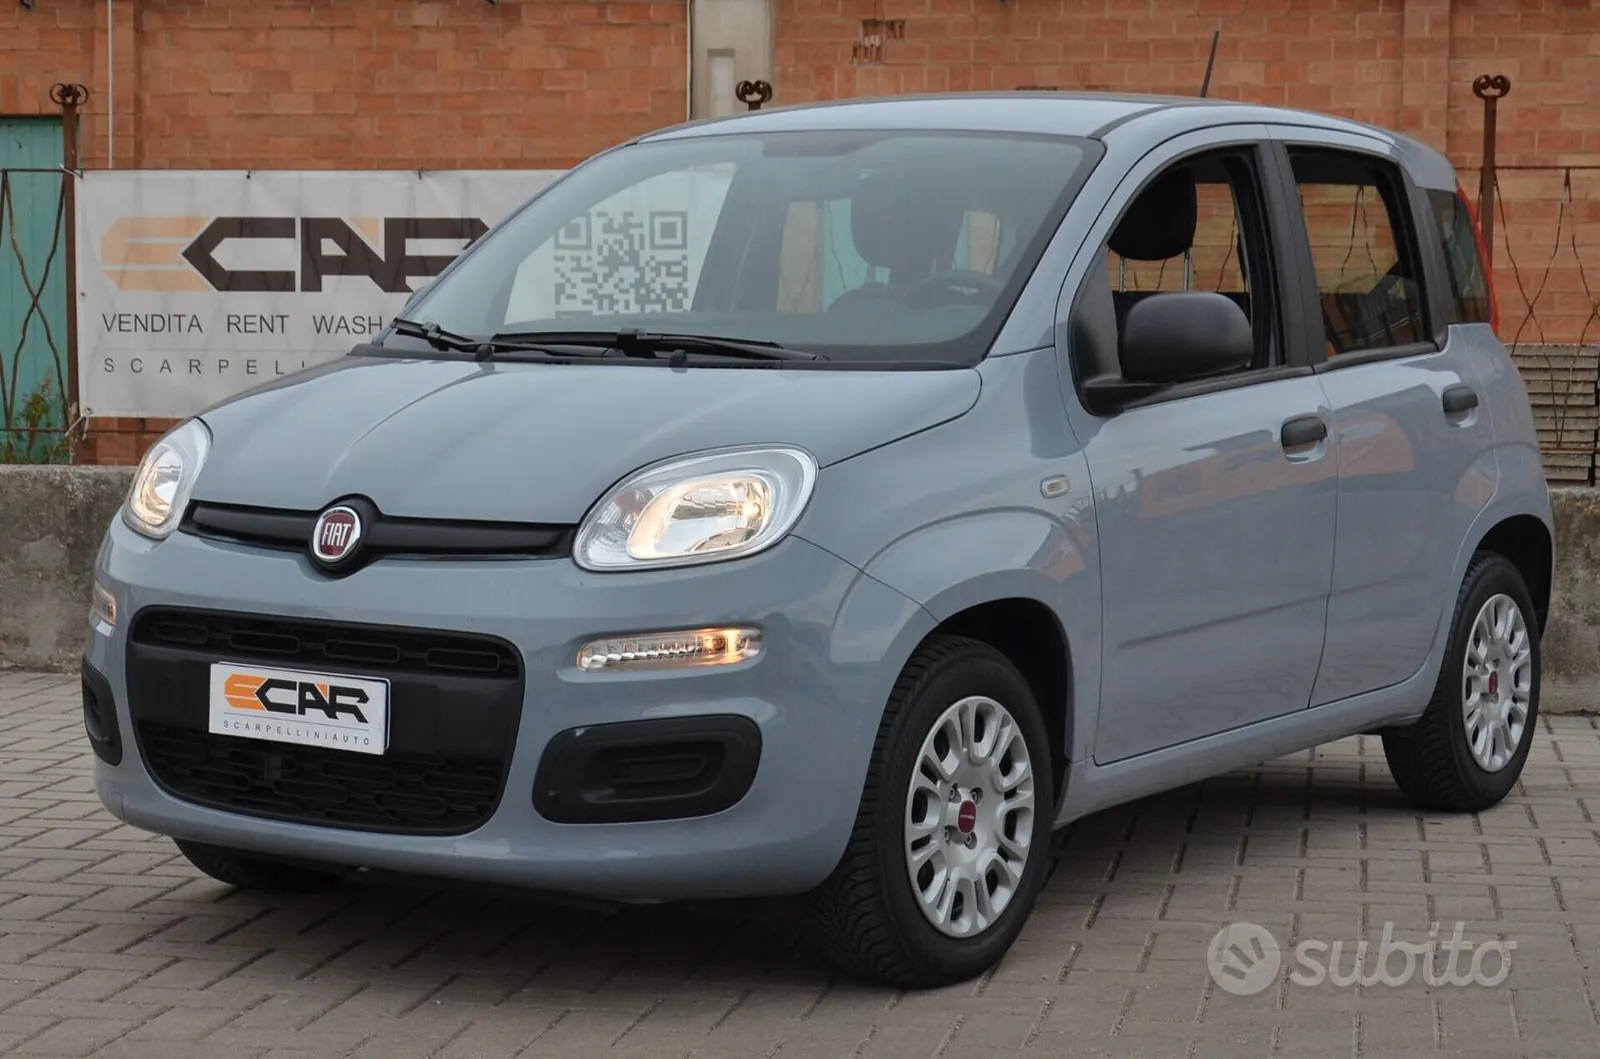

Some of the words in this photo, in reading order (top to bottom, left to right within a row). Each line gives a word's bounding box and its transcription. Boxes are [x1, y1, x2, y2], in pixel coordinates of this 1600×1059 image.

[101, 313, 203, 334] VENDITA
[226, 314, 290, 335] RENT
[312, 314, 383, 335] WASH
[321, 522, 352, 547] FIAT
[223, 719, 370, 746] SCARPELLINIAUTO
